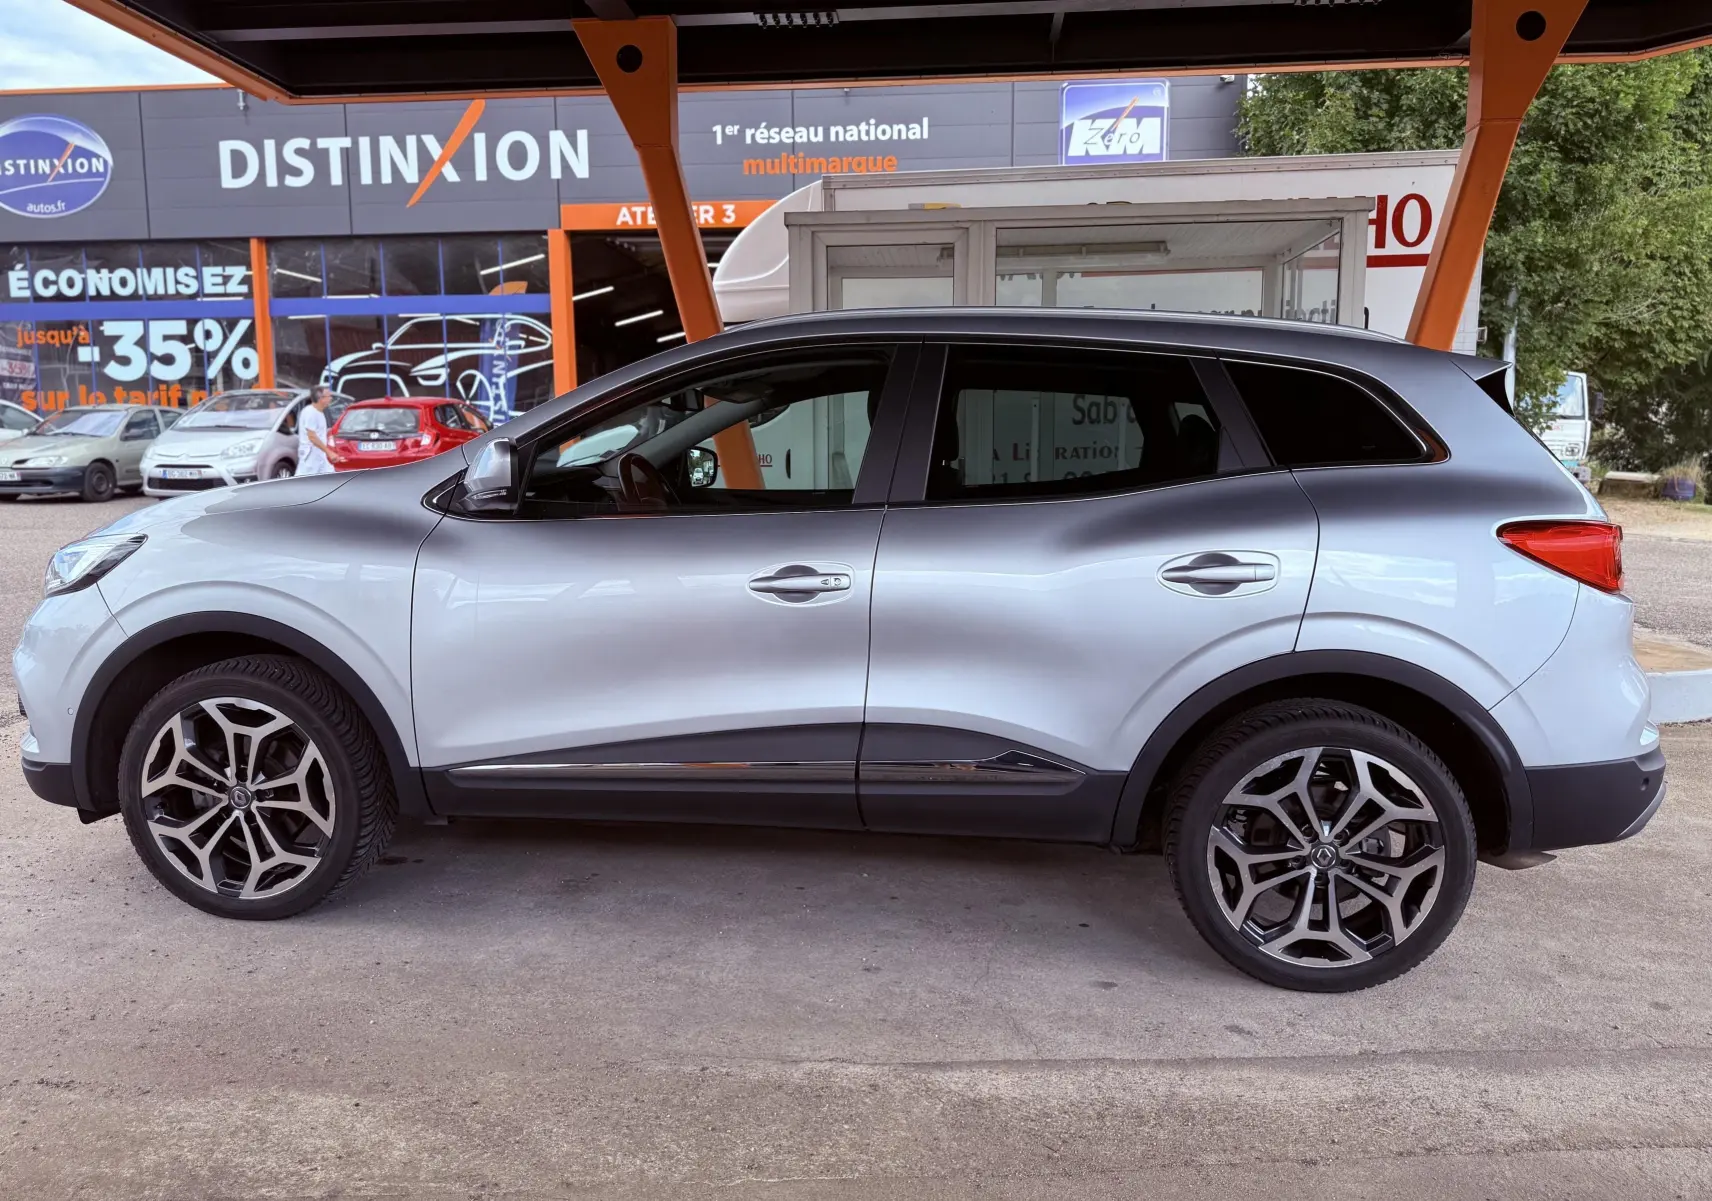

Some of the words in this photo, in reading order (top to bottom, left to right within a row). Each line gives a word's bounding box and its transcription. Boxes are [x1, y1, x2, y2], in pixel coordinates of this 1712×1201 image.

[745, 122, 824, 145] réseau
[830, 117, 929, 141] national
[1067, 118, 1161, 156] KM
[0, 151, 105, 180] STINXION
[219, 102, 590, 205] DISTINXION
[743, 151, 898, 174] multimarque
[26, 199, 66, 213] autos.fr
[616, 203, 715, 226] ATER
[721, 203, 736, 225] 3
[8, 263, 249, 298] ÉCONOMISEZ
[17, 324, 91, 348] jusqu'à
[77, 318, 260, 382] -35%
[20, 389, 69, 412] sur
[114, 384, 183, 408] tarif
